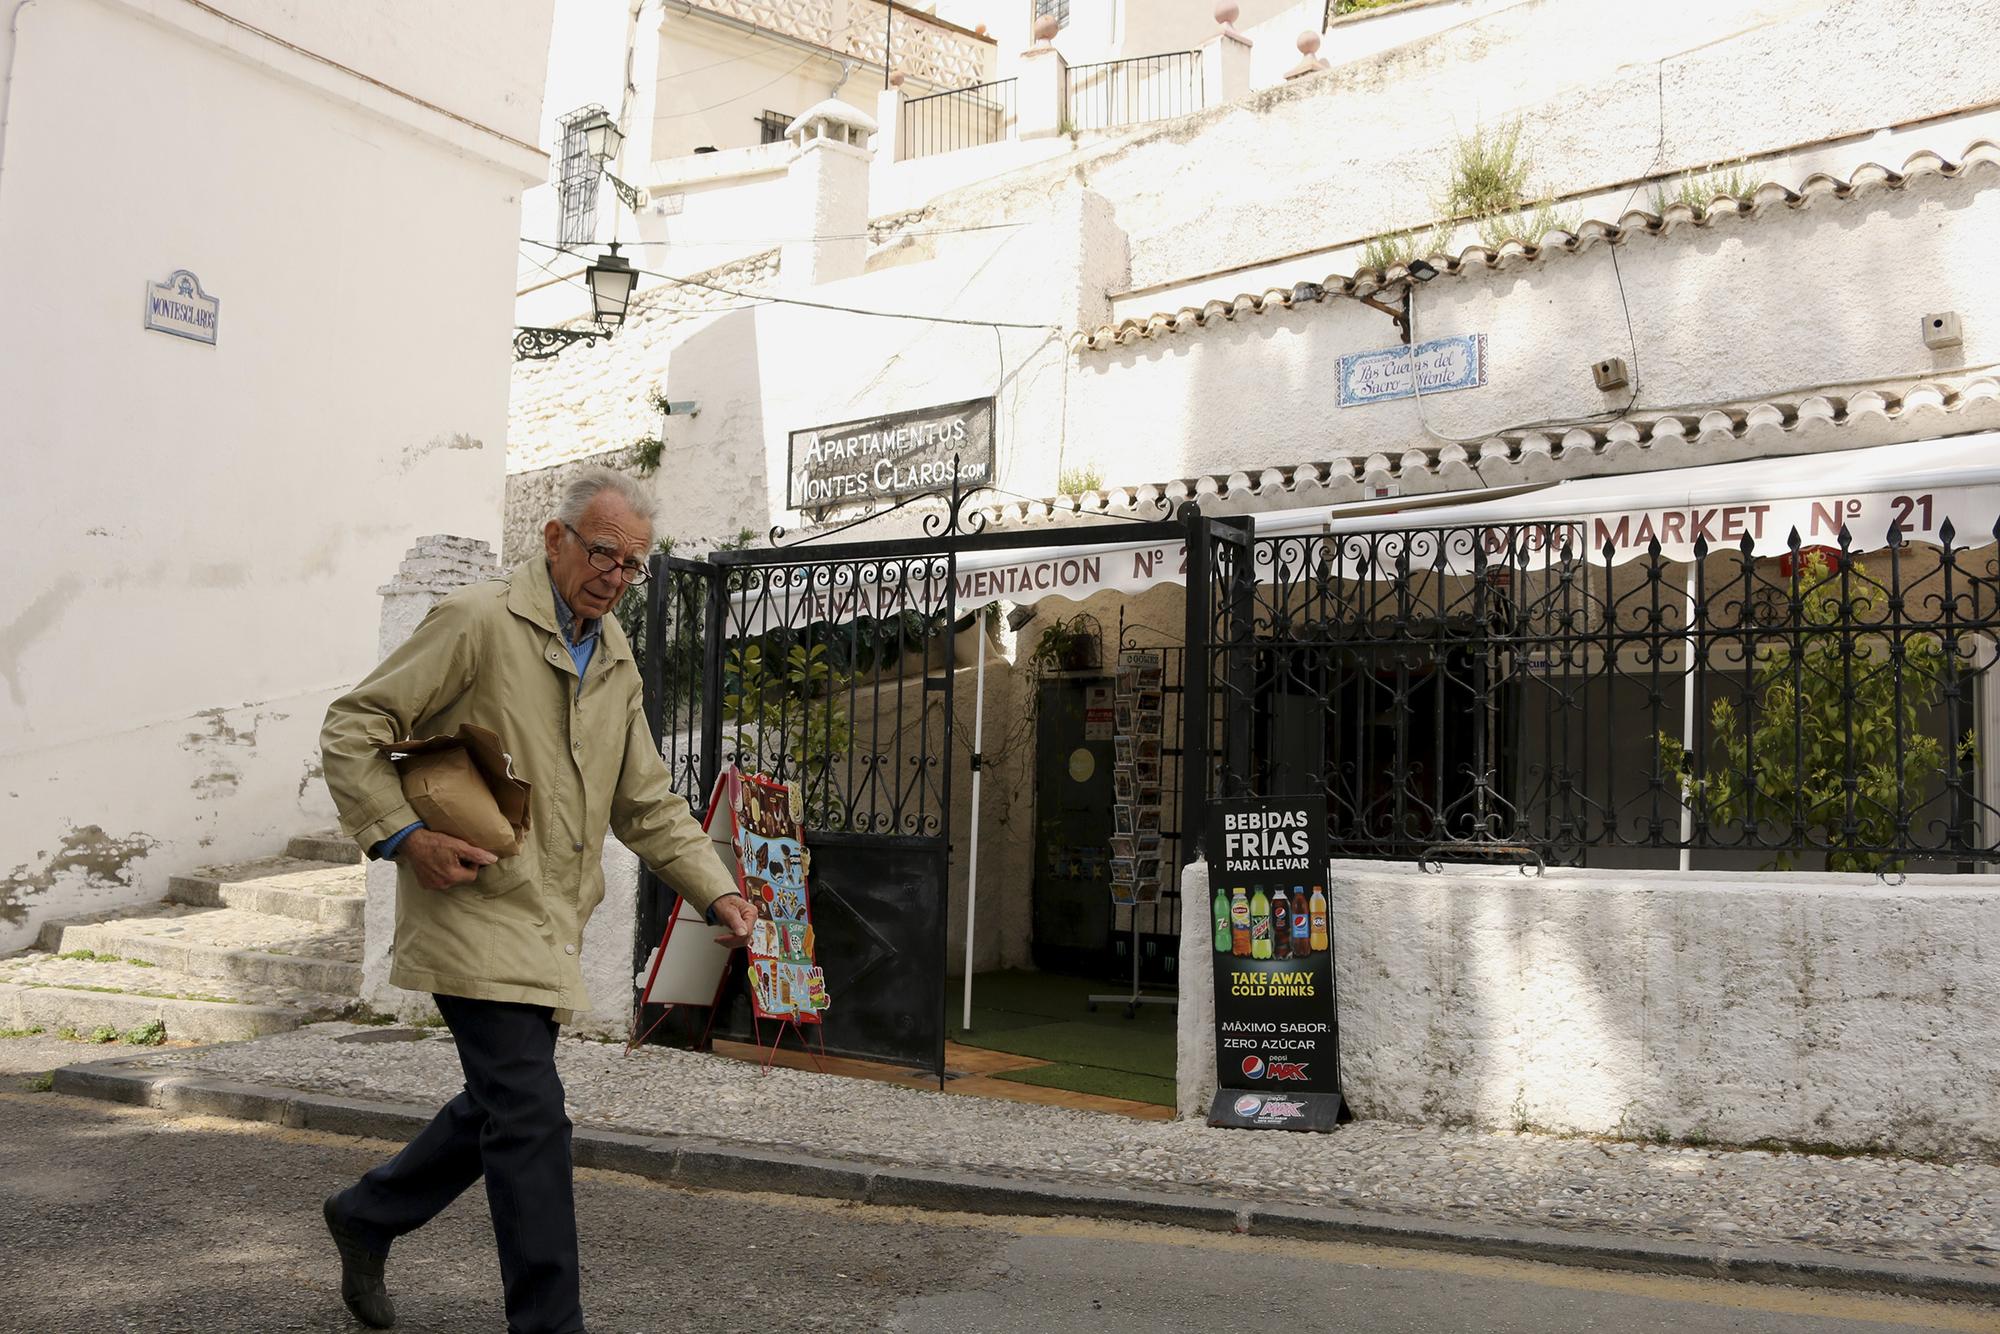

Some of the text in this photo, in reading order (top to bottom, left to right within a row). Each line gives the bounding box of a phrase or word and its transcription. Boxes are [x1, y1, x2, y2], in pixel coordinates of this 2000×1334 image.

[152, 297, 215, 329] MONTESCLAROS
[1357, 365, 1379, 383] Las
[1434, 351, 1454, 368] del
[806, 418, 966, 465] APARTAMENTOS
[792, 469, 869, 502] MONTES
[1594, 505, 1771, 551] MARKET
[1890, 494, 1933, 532] 21
[919, 556, 1101, 604] ALMENTACION
[1225, 811, 1308, 831] BEBIDAS
[1225, 828, 1310, 858] FRÍAS
[1226, 858, 1309, 871] PARA LLEVAR
[1231, 972, 1314, 985] TAKE AWAY
[1231, 985, 1315, 997] COLD DRINKS
[1223, 1020, 1277, 1033] MÁXIMO
[1224, 1037, 1315, 1050] ZERO AZÚCAR
[1266, 1062, 1310, 1081] MAX
